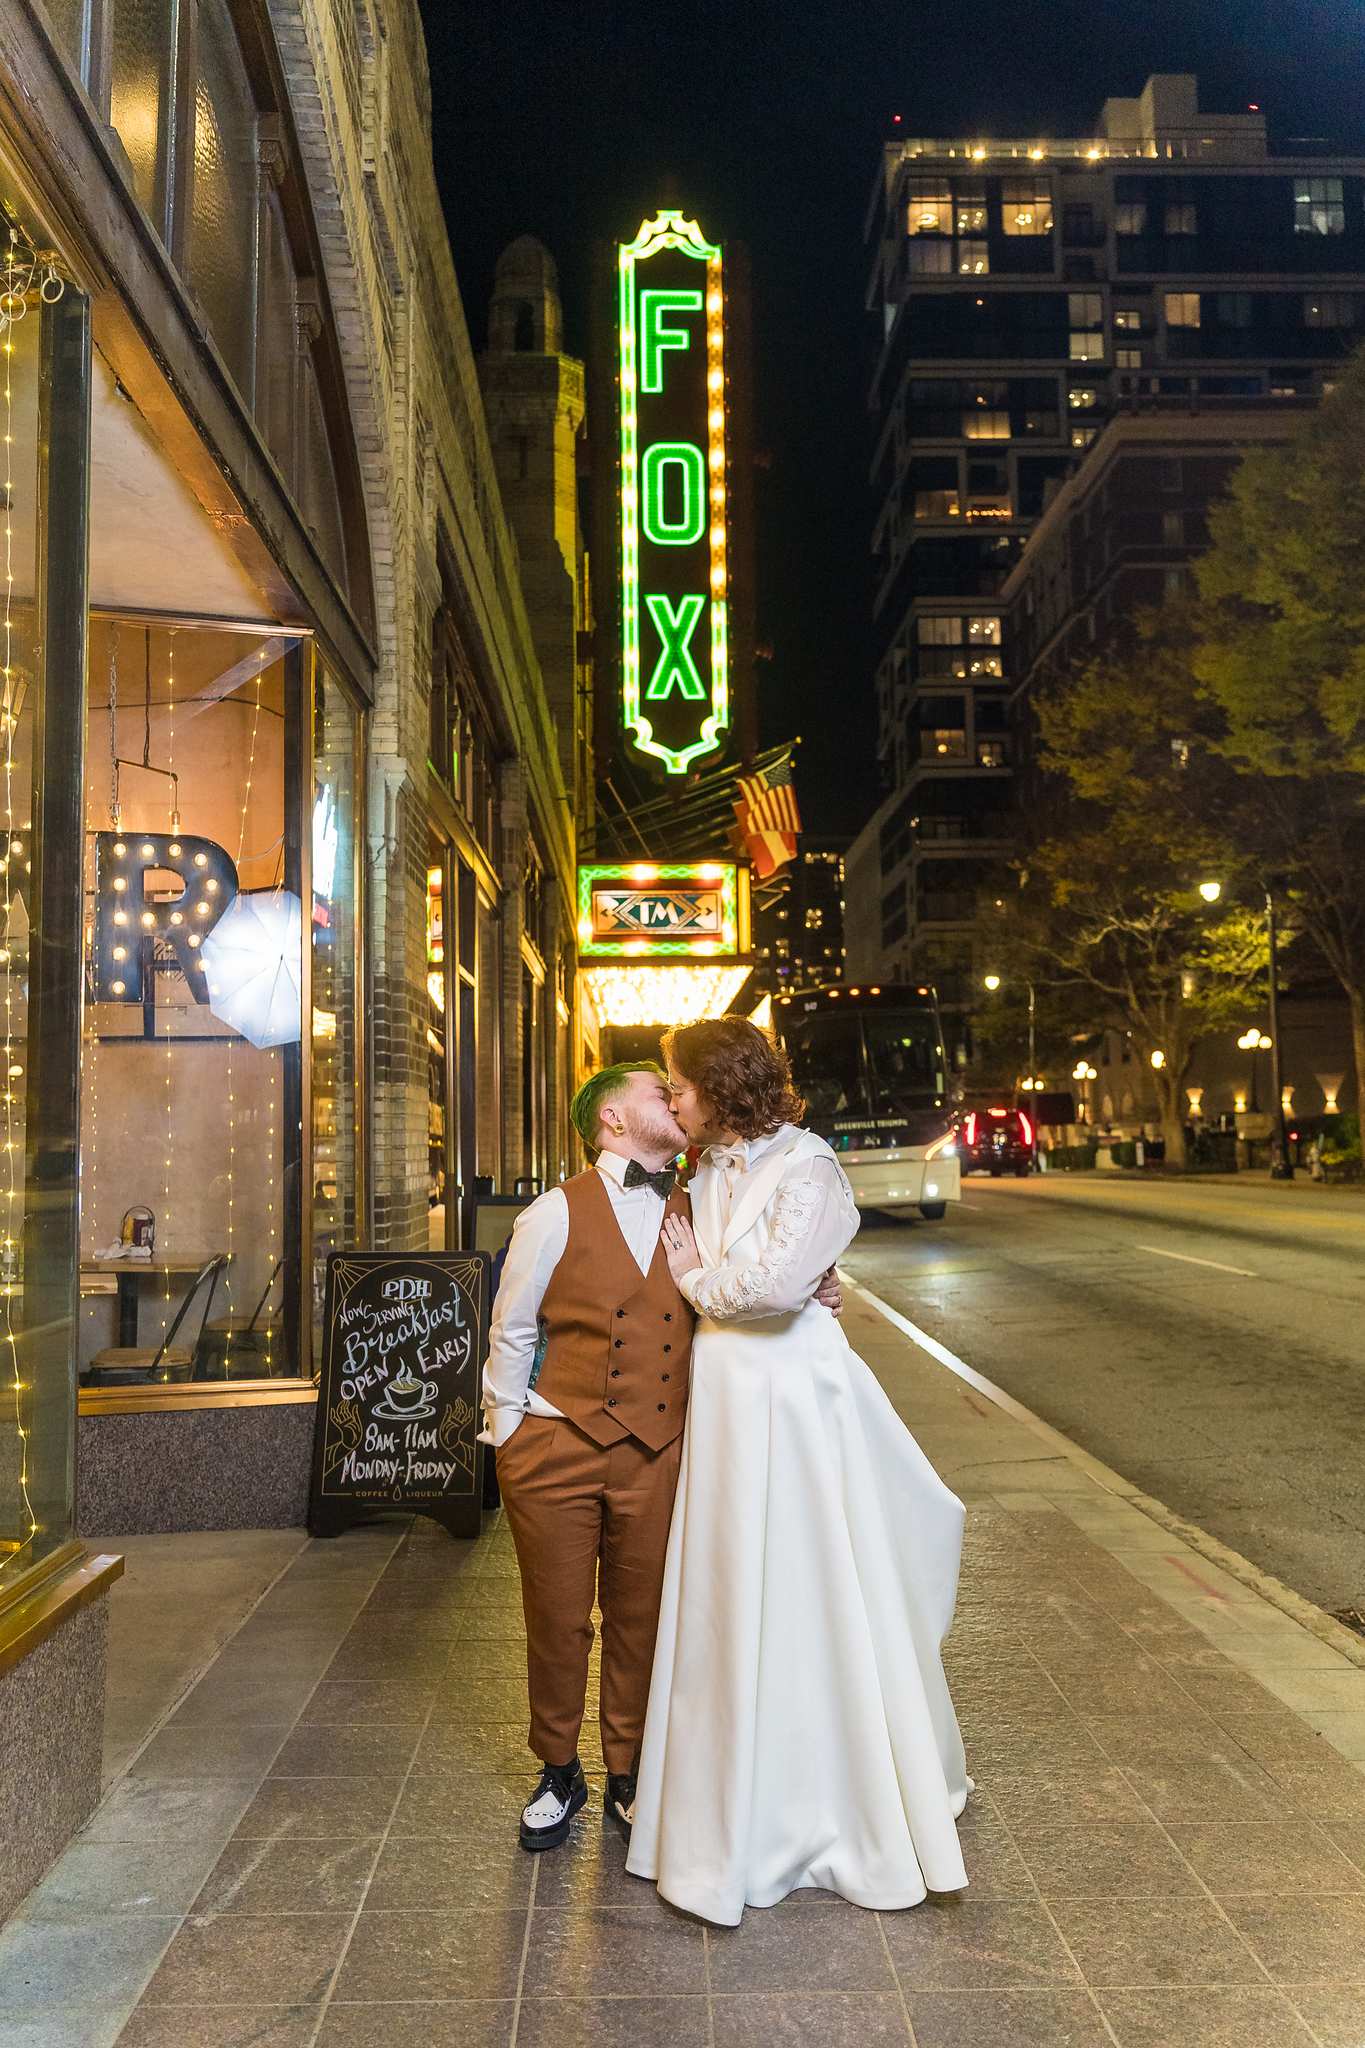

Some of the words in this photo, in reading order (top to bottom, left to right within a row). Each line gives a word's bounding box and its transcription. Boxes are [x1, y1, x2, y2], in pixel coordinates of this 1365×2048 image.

[640, 289, 708, 701] FOX
[97, 832, 239, 1005] R
[636, 901, 680, 925] TM
[340, 1356, 389, 1402] OPEN
[417, 1328, 471, 1375] EARLY
[342, 1282, 466, 1374] Breakfast
